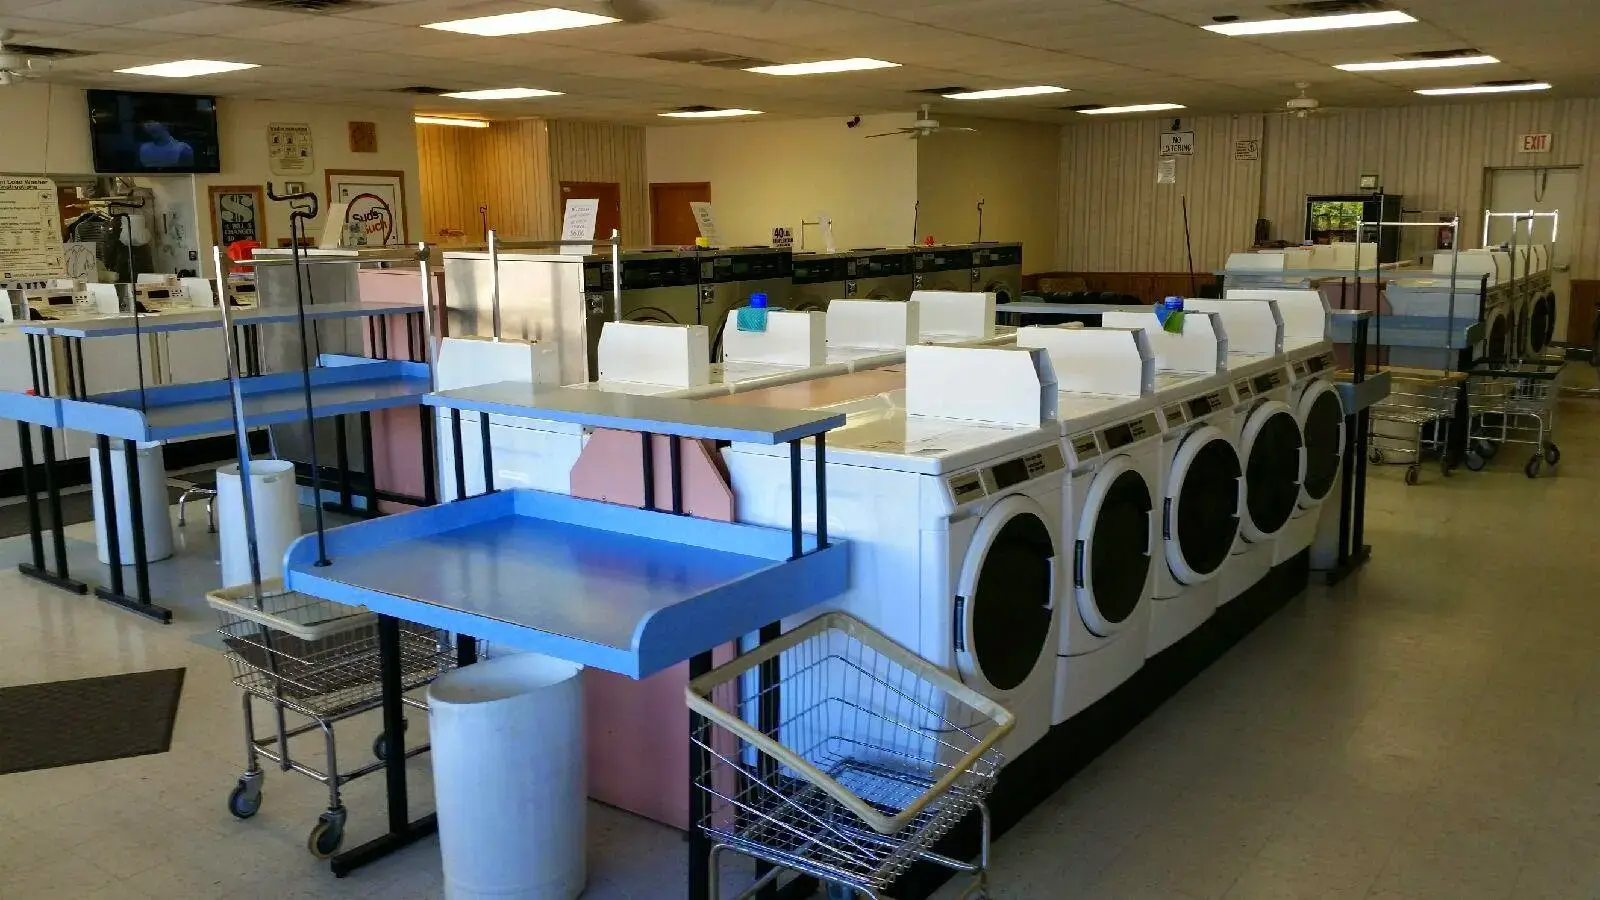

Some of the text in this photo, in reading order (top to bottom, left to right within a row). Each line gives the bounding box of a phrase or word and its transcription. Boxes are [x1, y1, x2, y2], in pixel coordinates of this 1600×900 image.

[1172, 136, 1182, 144] NO
[1524, 135, 1547, 150] EXIT
[774, 227, 784, 238] 40
